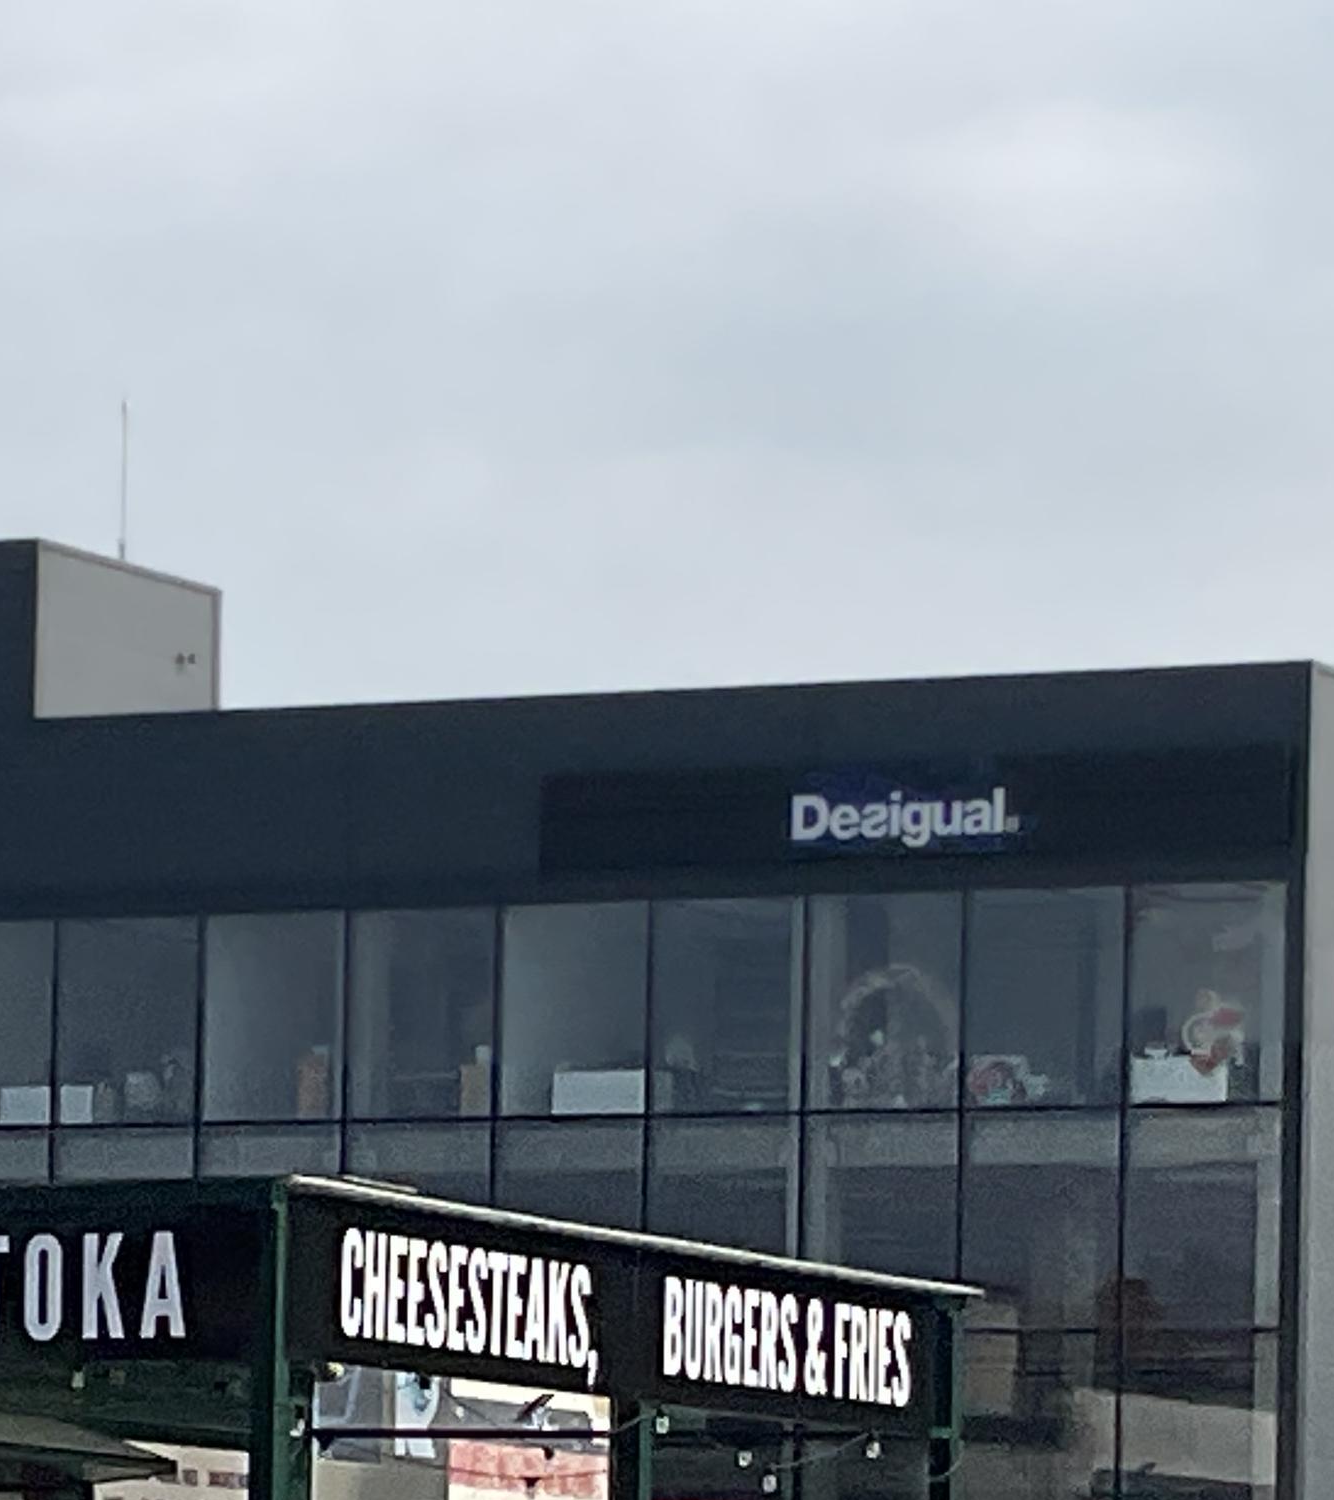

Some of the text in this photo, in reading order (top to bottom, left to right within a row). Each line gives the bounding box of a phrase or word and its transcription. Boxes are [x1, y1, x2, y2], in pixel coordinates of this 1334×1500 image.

[340, 1227, 912, 1408] CHEESESTEAKS, BURGERS & FRIES
